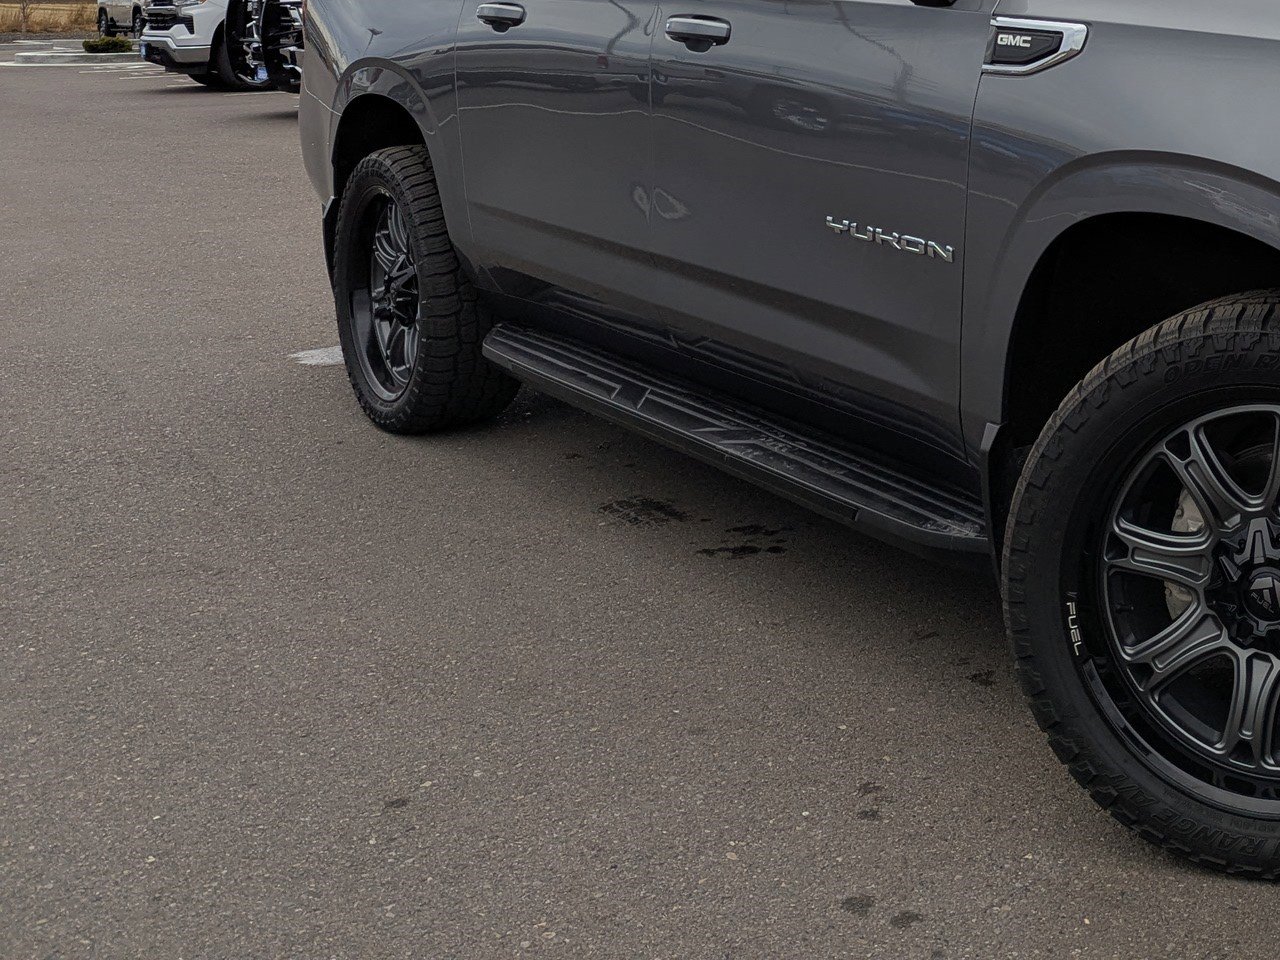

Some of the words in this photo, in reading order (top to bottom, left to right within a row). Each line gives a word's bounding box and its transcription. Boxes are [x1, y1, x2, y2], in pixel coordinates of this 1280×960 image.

[997, 33, 1032, 48] GMC
[826, 215, 955, 263] YUKON
[1065, 601, 1083, 656] FUEL
